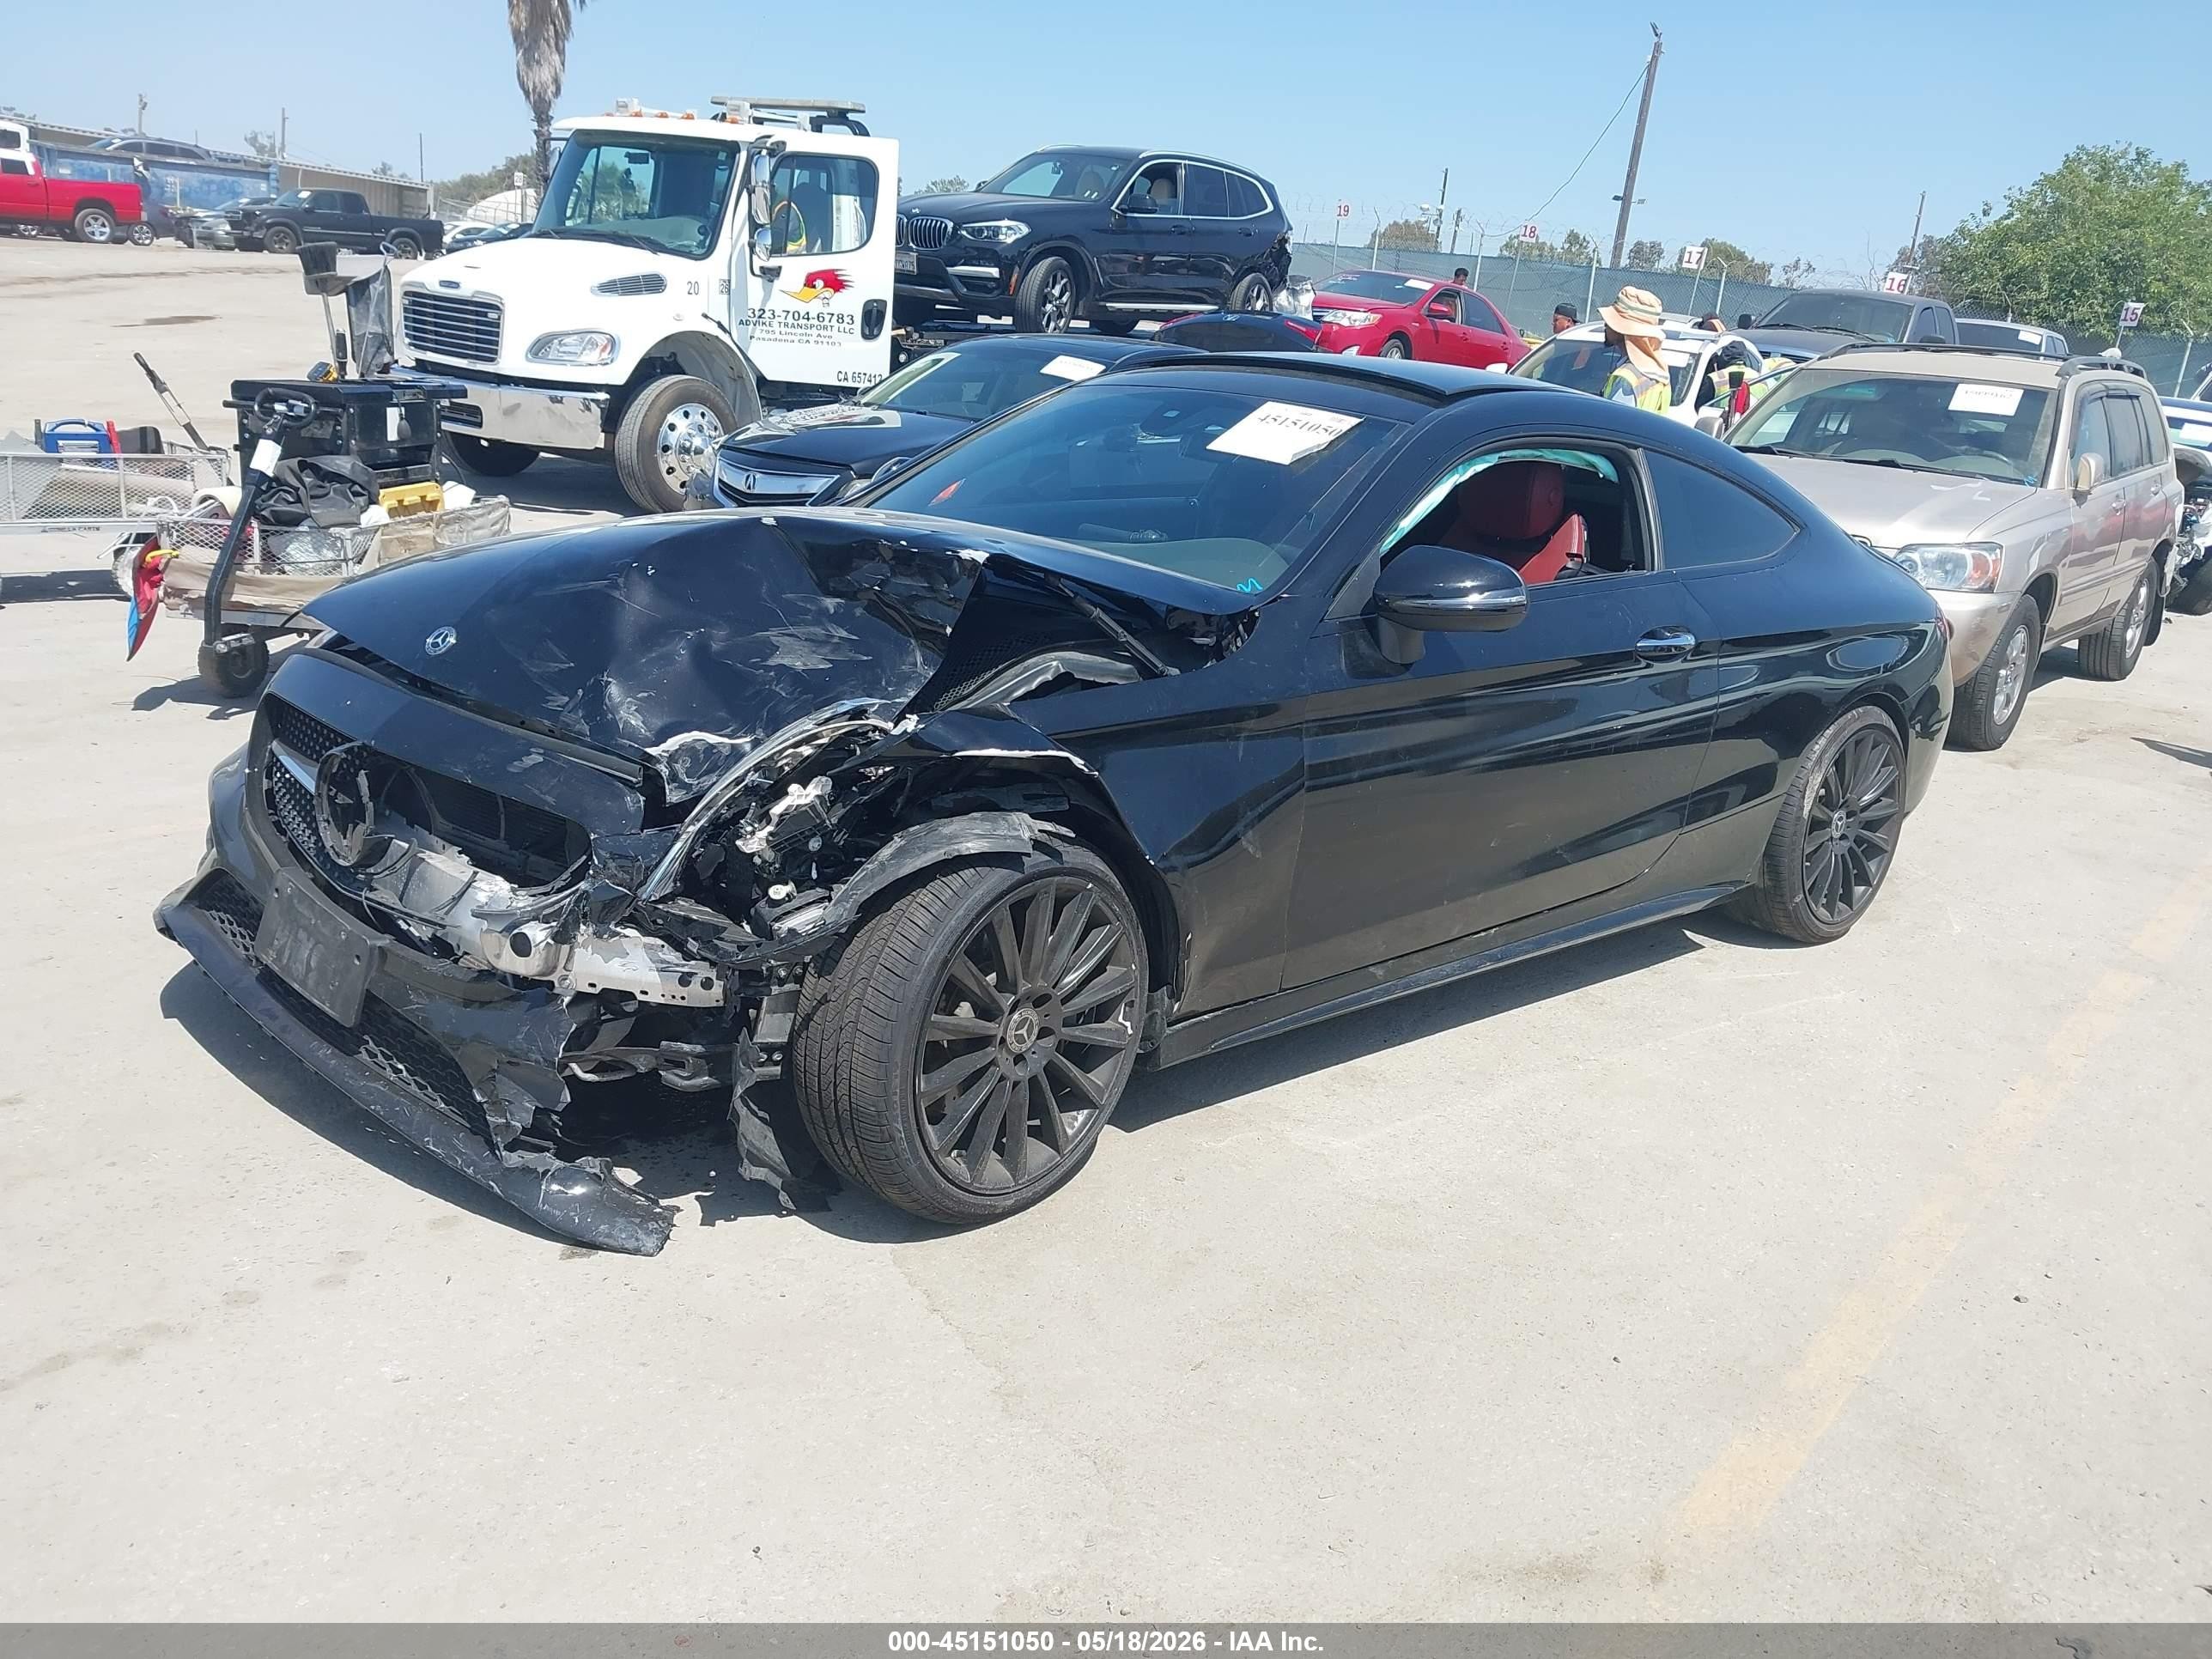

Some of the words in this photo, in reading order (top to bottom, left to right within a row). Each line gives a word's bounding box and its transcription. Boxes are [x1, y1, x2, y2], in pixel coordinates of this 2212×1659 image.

[1336, 204, 1351, 217] 19
[1521, 224, 1537, 239] 18
[1684, 250, 1705, 265] 17
[687, 281, 700, 295] 20
[1885, 277, 1908, 293] 16
[747, 307, 855, 325] 323-704-6783
[2121, 307, 2141, 322] 15
[738, 319, 775, 329] ADVIKE
[778, 321, 835, 332] TRANSPORT
[837, 326, 855, 335] LLC
[749, 335, 795, 344] Pasadena
[836, 371, 848, 383] CA
[1257, 414, 1343, 436] 45151050
